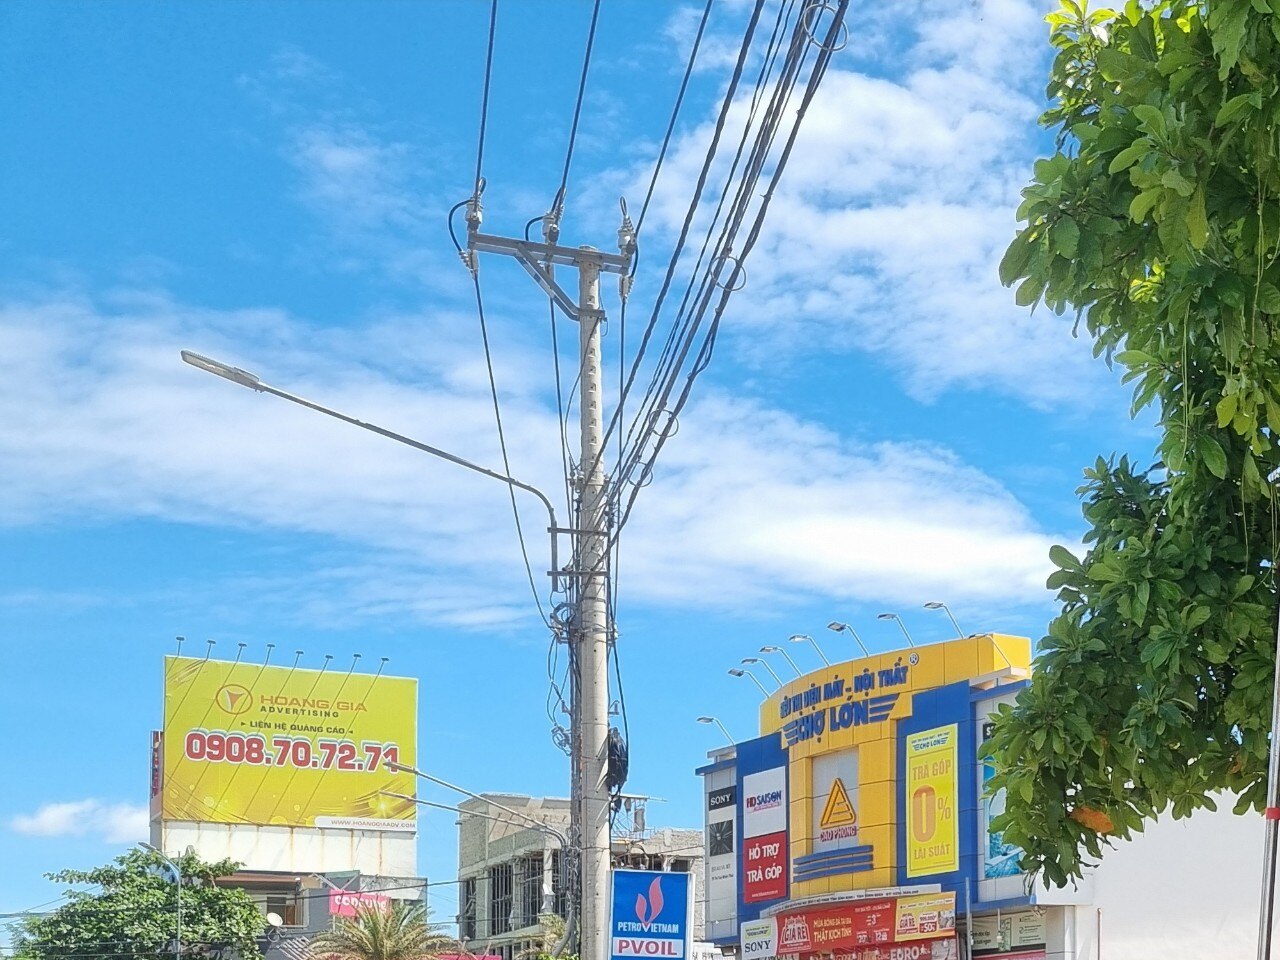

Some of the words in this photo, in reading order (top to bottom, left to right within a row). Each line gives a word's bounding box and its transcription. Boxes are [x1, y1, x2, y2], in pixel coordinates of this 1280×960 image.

[824, 674, 845, 701] MÁY
[854, 668, 875, 697] NỘI
[878, 656, 908, 688] THẤT
[260, 705, 340, 718] ADVERTISING
[336, 701, 367, 712] GIA
[797, 709, 826, 743] CHỢ
[830, 695, 869, 732] LỚN
[274, 721, 287, 732] HỆ
[326, 724, 346, 735] CÁO
[186, 731, 399, 773] 0908.70.72.71
[932, 759, 951, 776] GÓP
[710, 793, 731, 806] SONY
[762, 842, 779, 858] TRỢ
[747, 865, 763, 883] TRẢ
[765, 862, 783, 879] GÓP
[617, 921, 679, 934] PETROVIETNAM
[618, 939, 678, 955] PVOIL
[744, 940, 771, 953] SONY
